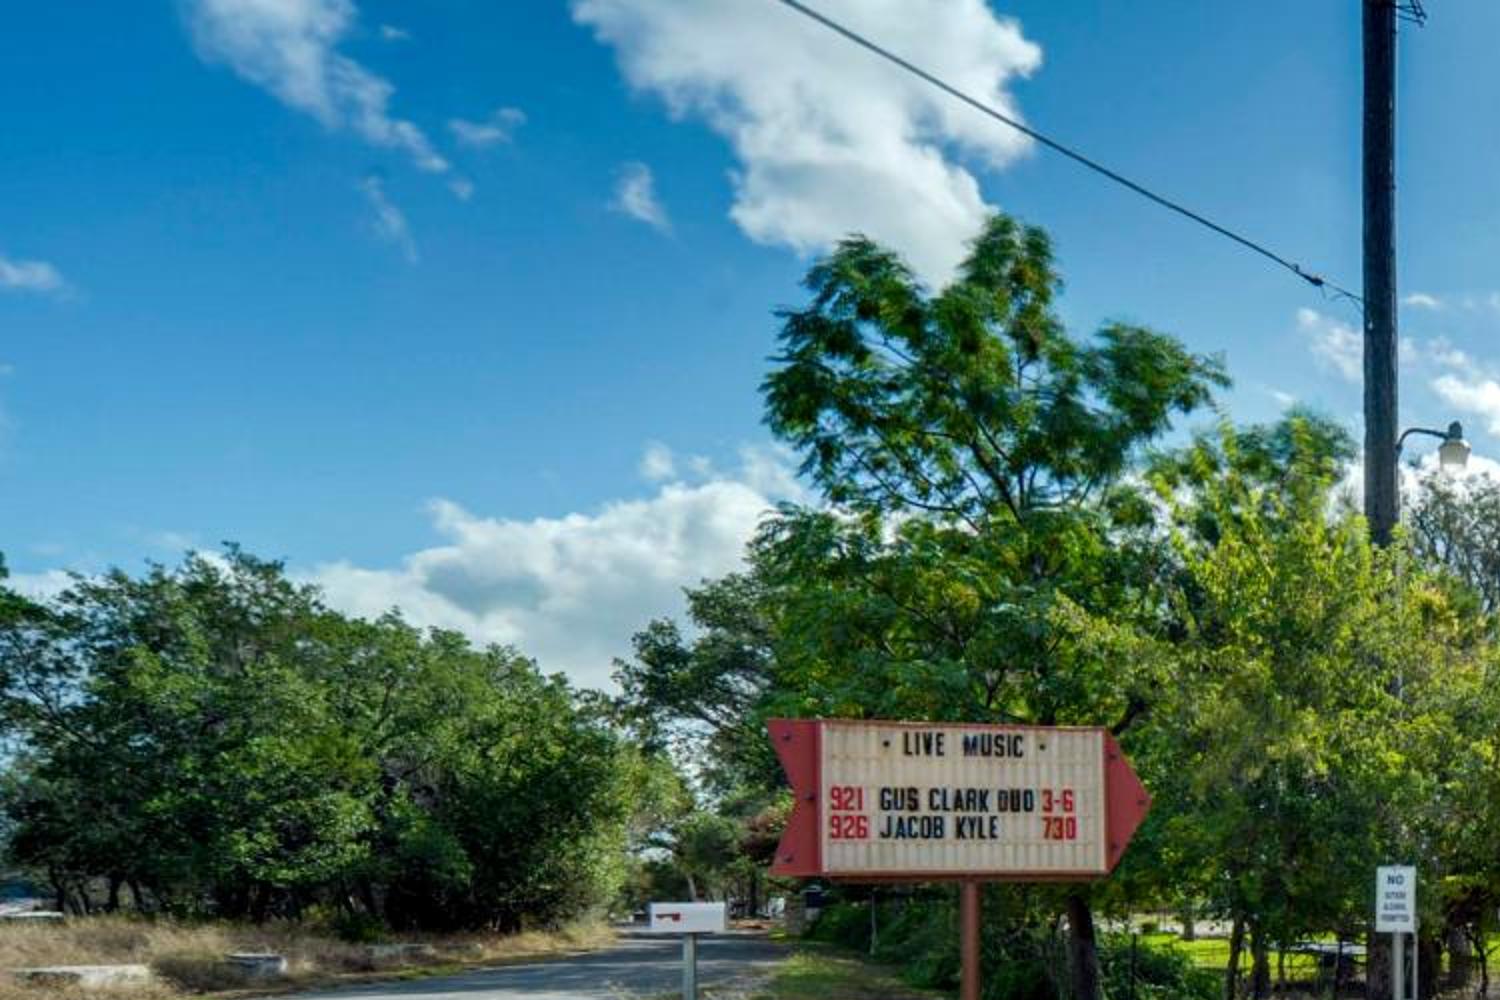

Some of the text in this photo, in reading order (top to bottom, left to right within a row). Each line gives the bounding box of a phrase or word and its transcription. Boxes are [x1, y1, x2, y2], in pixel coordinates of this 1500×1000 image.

[902, 732, 1025, 757] LIVE MUSIC
[829, 786, 1074, 813] 921 GUS CLARK DUO 3-6
[829, 815, 1077, 840] 926 JACOB KYLE 730
[1387, 874, 1405, 885] NO
